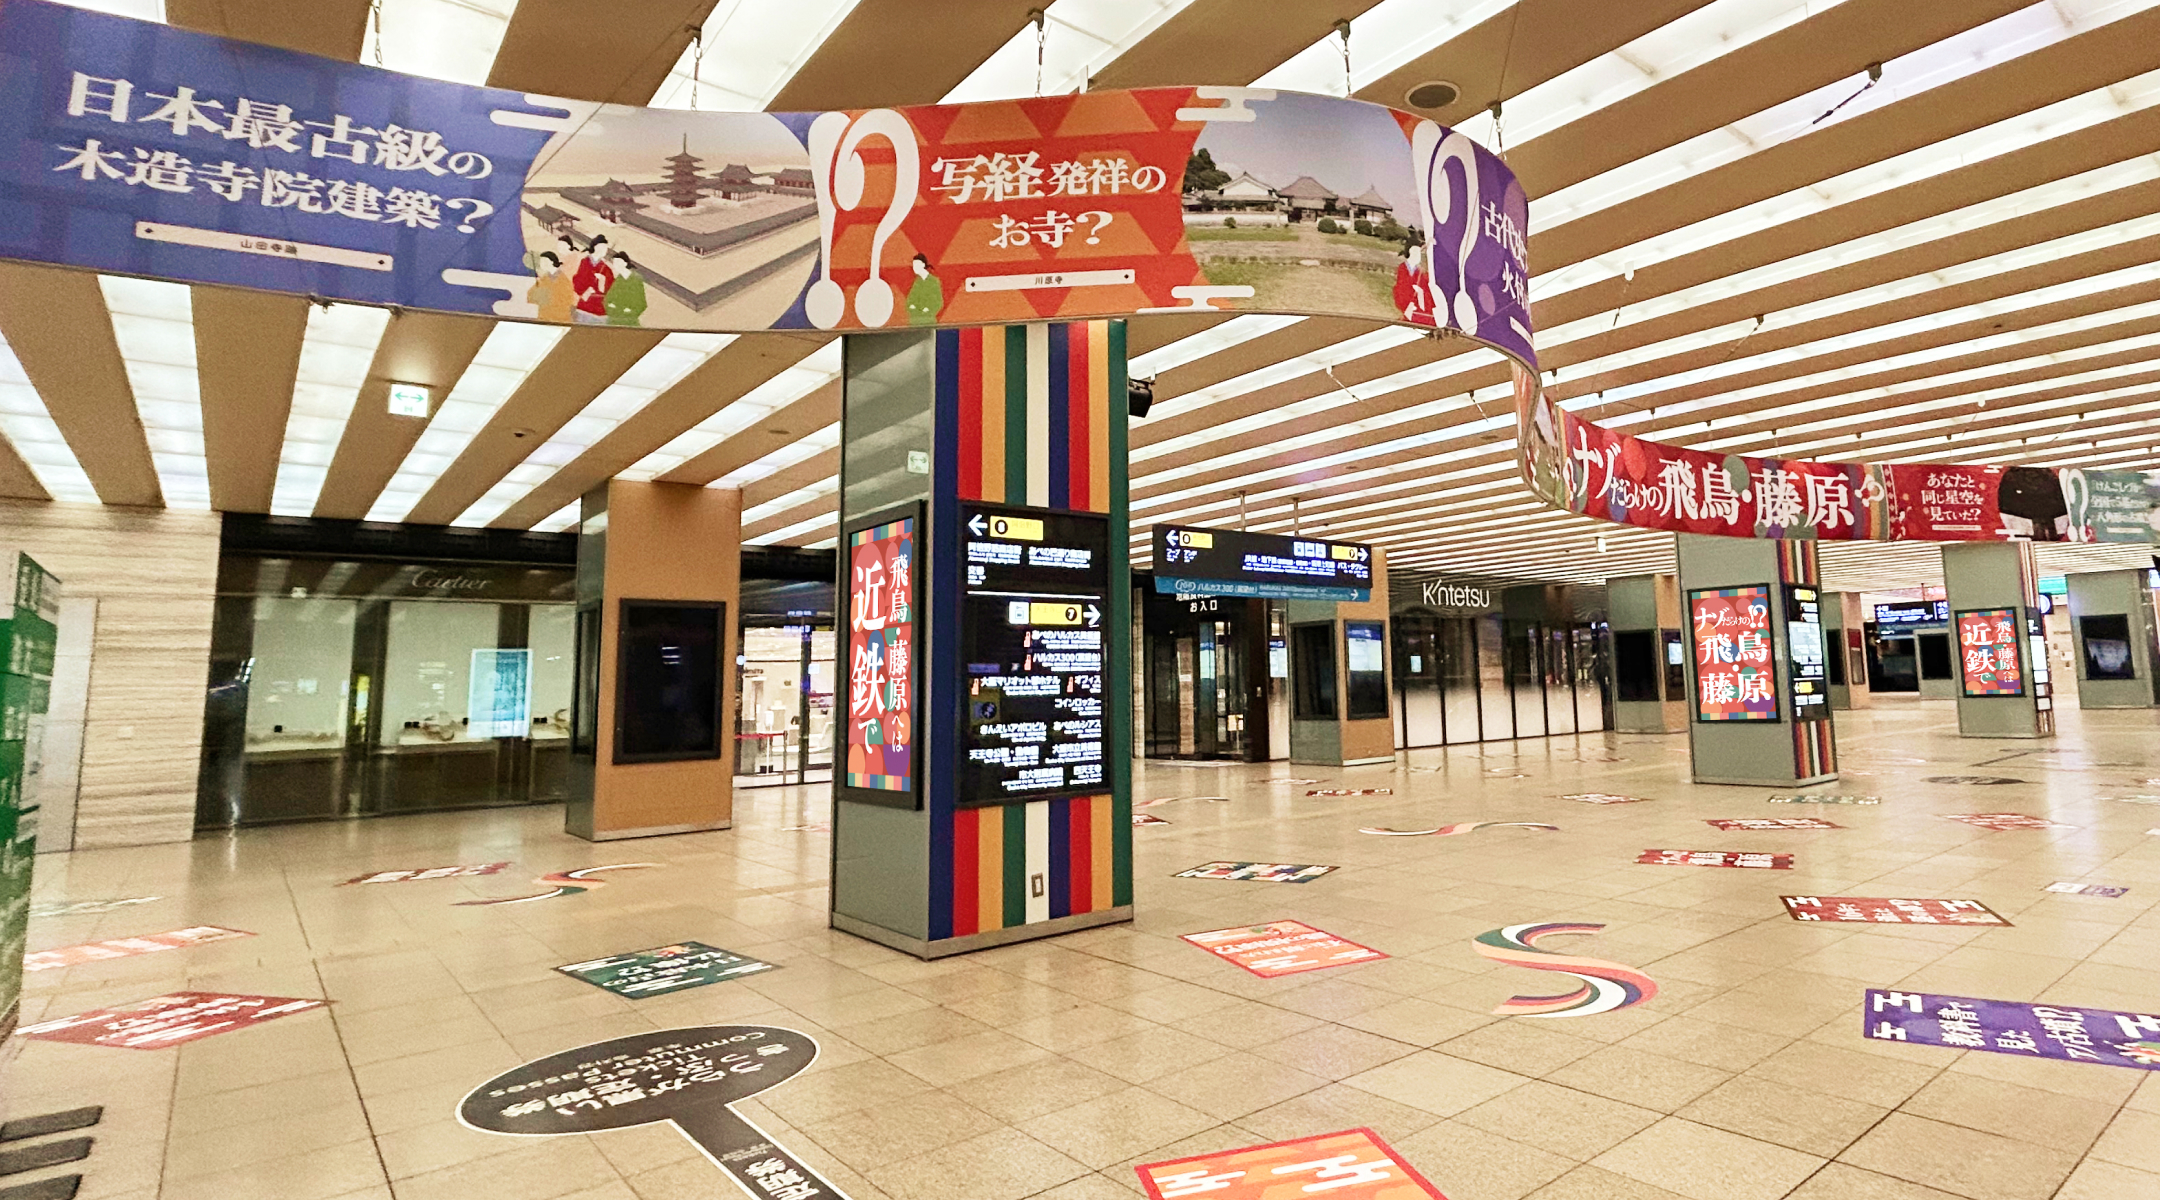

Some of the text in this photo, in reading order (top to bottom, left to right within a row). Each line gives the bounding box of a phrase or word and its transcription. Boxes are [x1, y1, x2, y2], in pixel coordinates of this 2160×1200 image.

[65, 71, 494, 181] 日本最古級の
[53, 139, 494, 235] 木造寺院建築?
[929, 151, 1167, 205] 写経発祥の
[988, 209, 1114, 250] お寺?
[1921, 489, 1984, 505] 同じ星空を
[1927, 472, 1976, 489] あなたと
[1929, 506, 1982, 522] 見ていた?
[412, 569, 494, 590] Cartier
[851, 560, 886, 755] 近鉄で
[889, 553, 909, 753] 飛鳥・藤原へは
[1698, 630, 1769, 665] 飛鳥
[1963, 621, 1996, 685] 近鉄で
[1054, 697, 1102, 708] コインロッカー
[1700, 670, 1772, 705] 藤原
[488, 1031, 766, 1098] Commuter Passes
[584, 1053, 707, 1085] Tickets
[555, 1059, 766, 1116] うらが黒い
